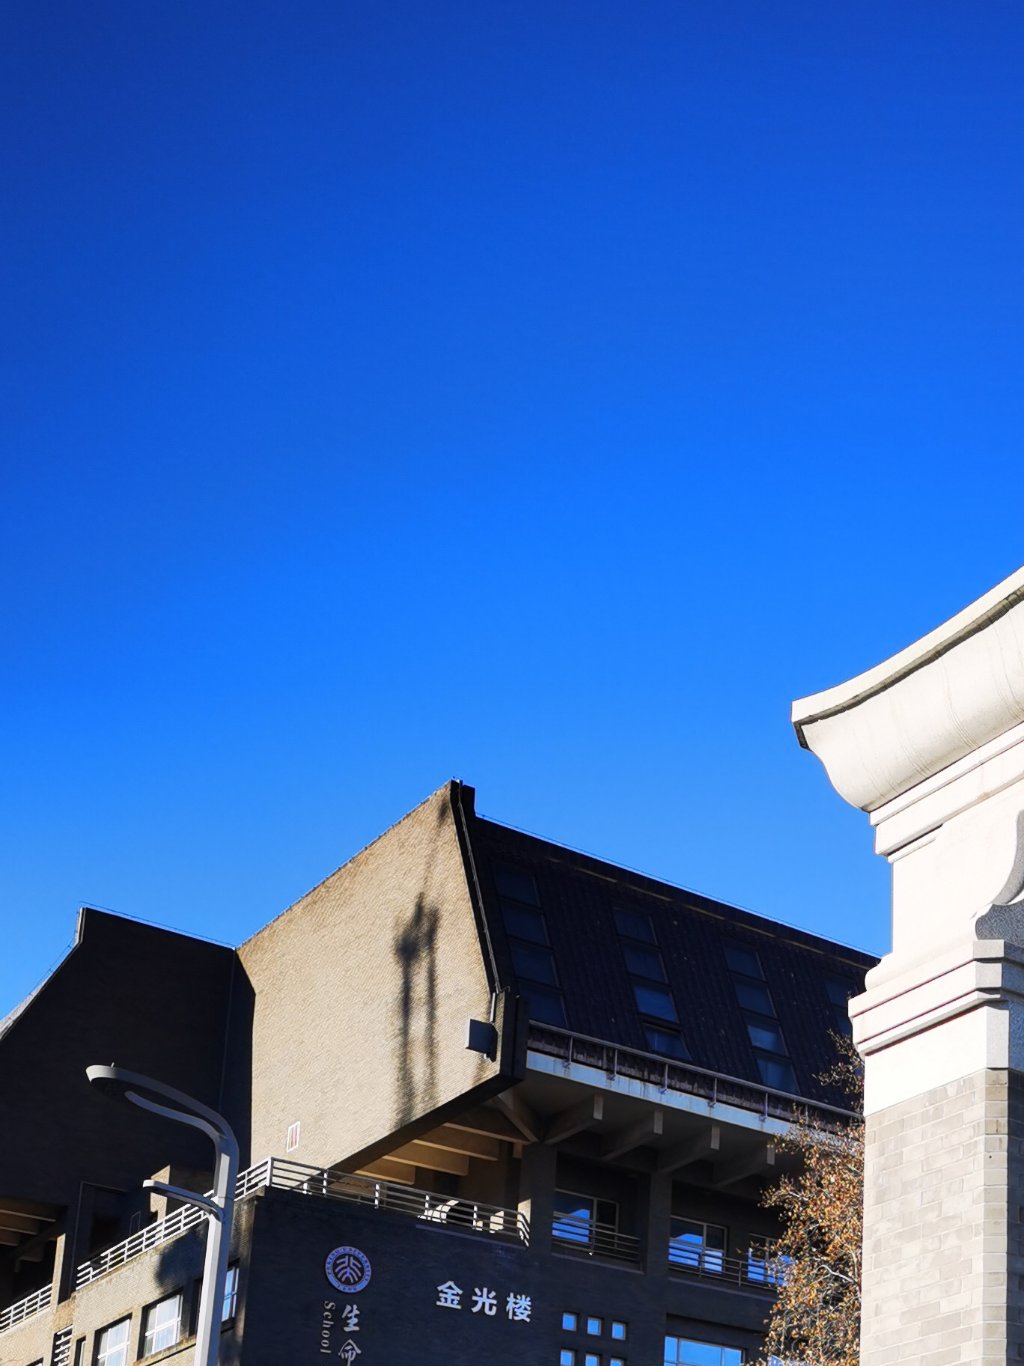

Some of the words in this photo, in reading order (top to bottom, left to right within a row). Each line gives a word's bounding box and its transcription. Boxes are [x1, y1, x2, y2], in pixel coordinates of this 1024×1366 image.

[435, 1280, 533, 1323] 金光楼
[320, 1300, 336, 1354] School
